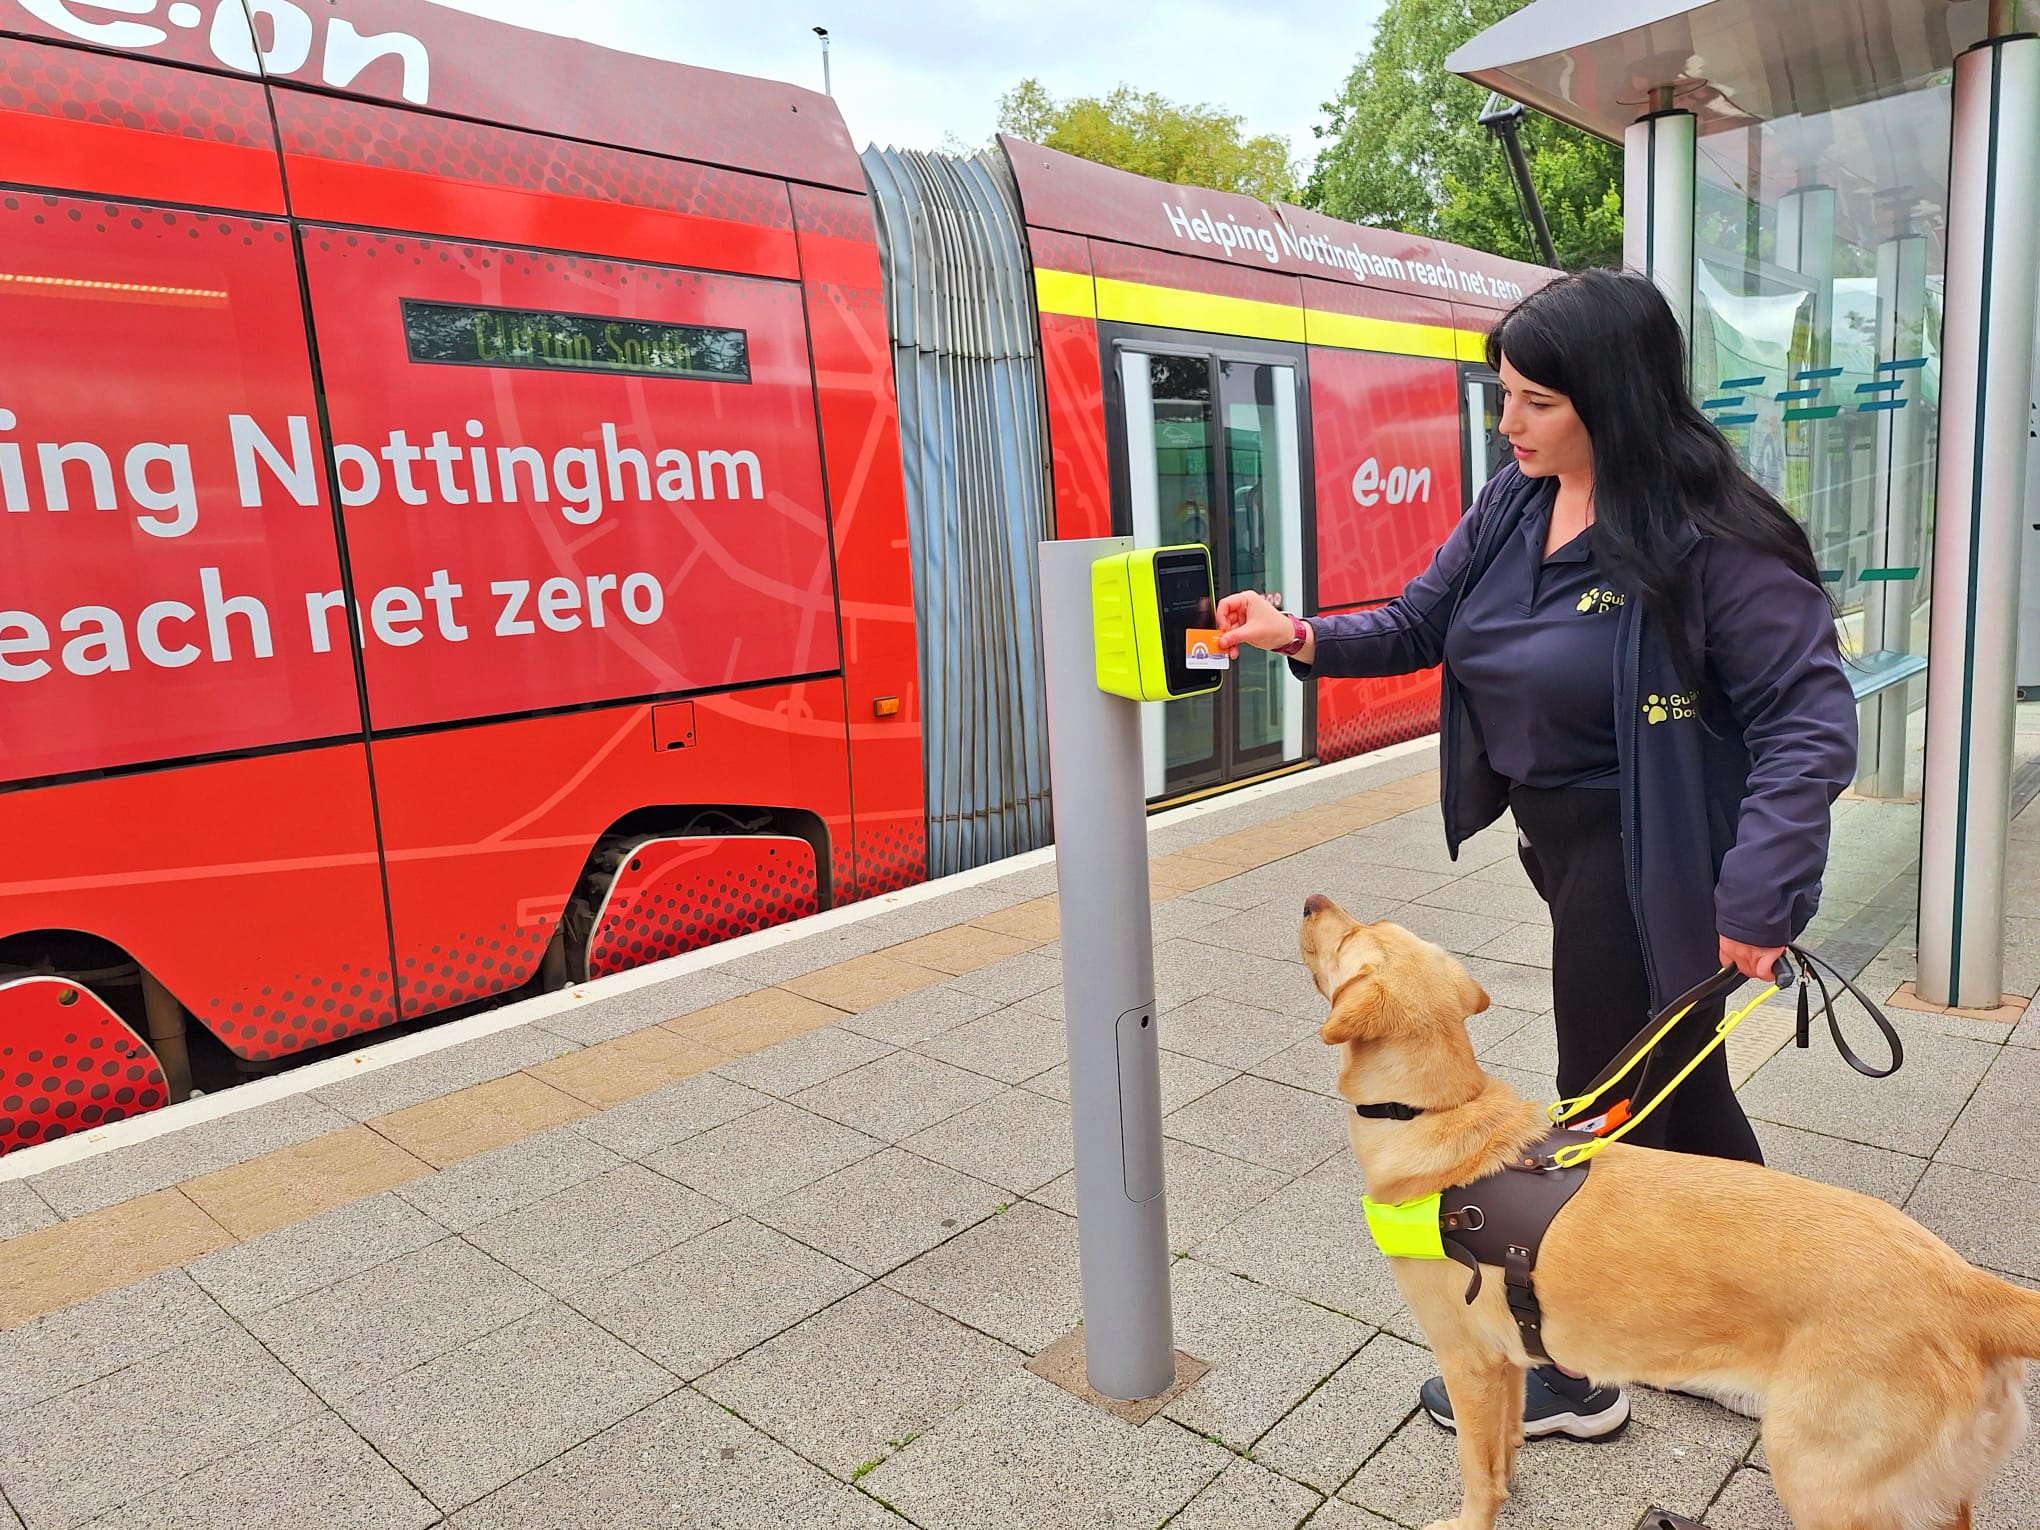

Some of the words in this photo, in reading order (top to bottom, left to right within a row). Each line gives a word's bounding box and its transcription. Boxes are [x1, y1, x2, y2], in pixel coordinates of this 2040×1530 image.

[1162, 202, 1280, 264] Helping
[1273, 222, 1406, 282] Nottingham
[1406, 257, 1459, 290] reach
[1458, 271, 1489, 296] net
[1488, 276, 1523, 301] zero
[229, 415, 763, 524] Nottingham
[306, 580, 468, 652] net
[491, 573, 663, 636] zero
